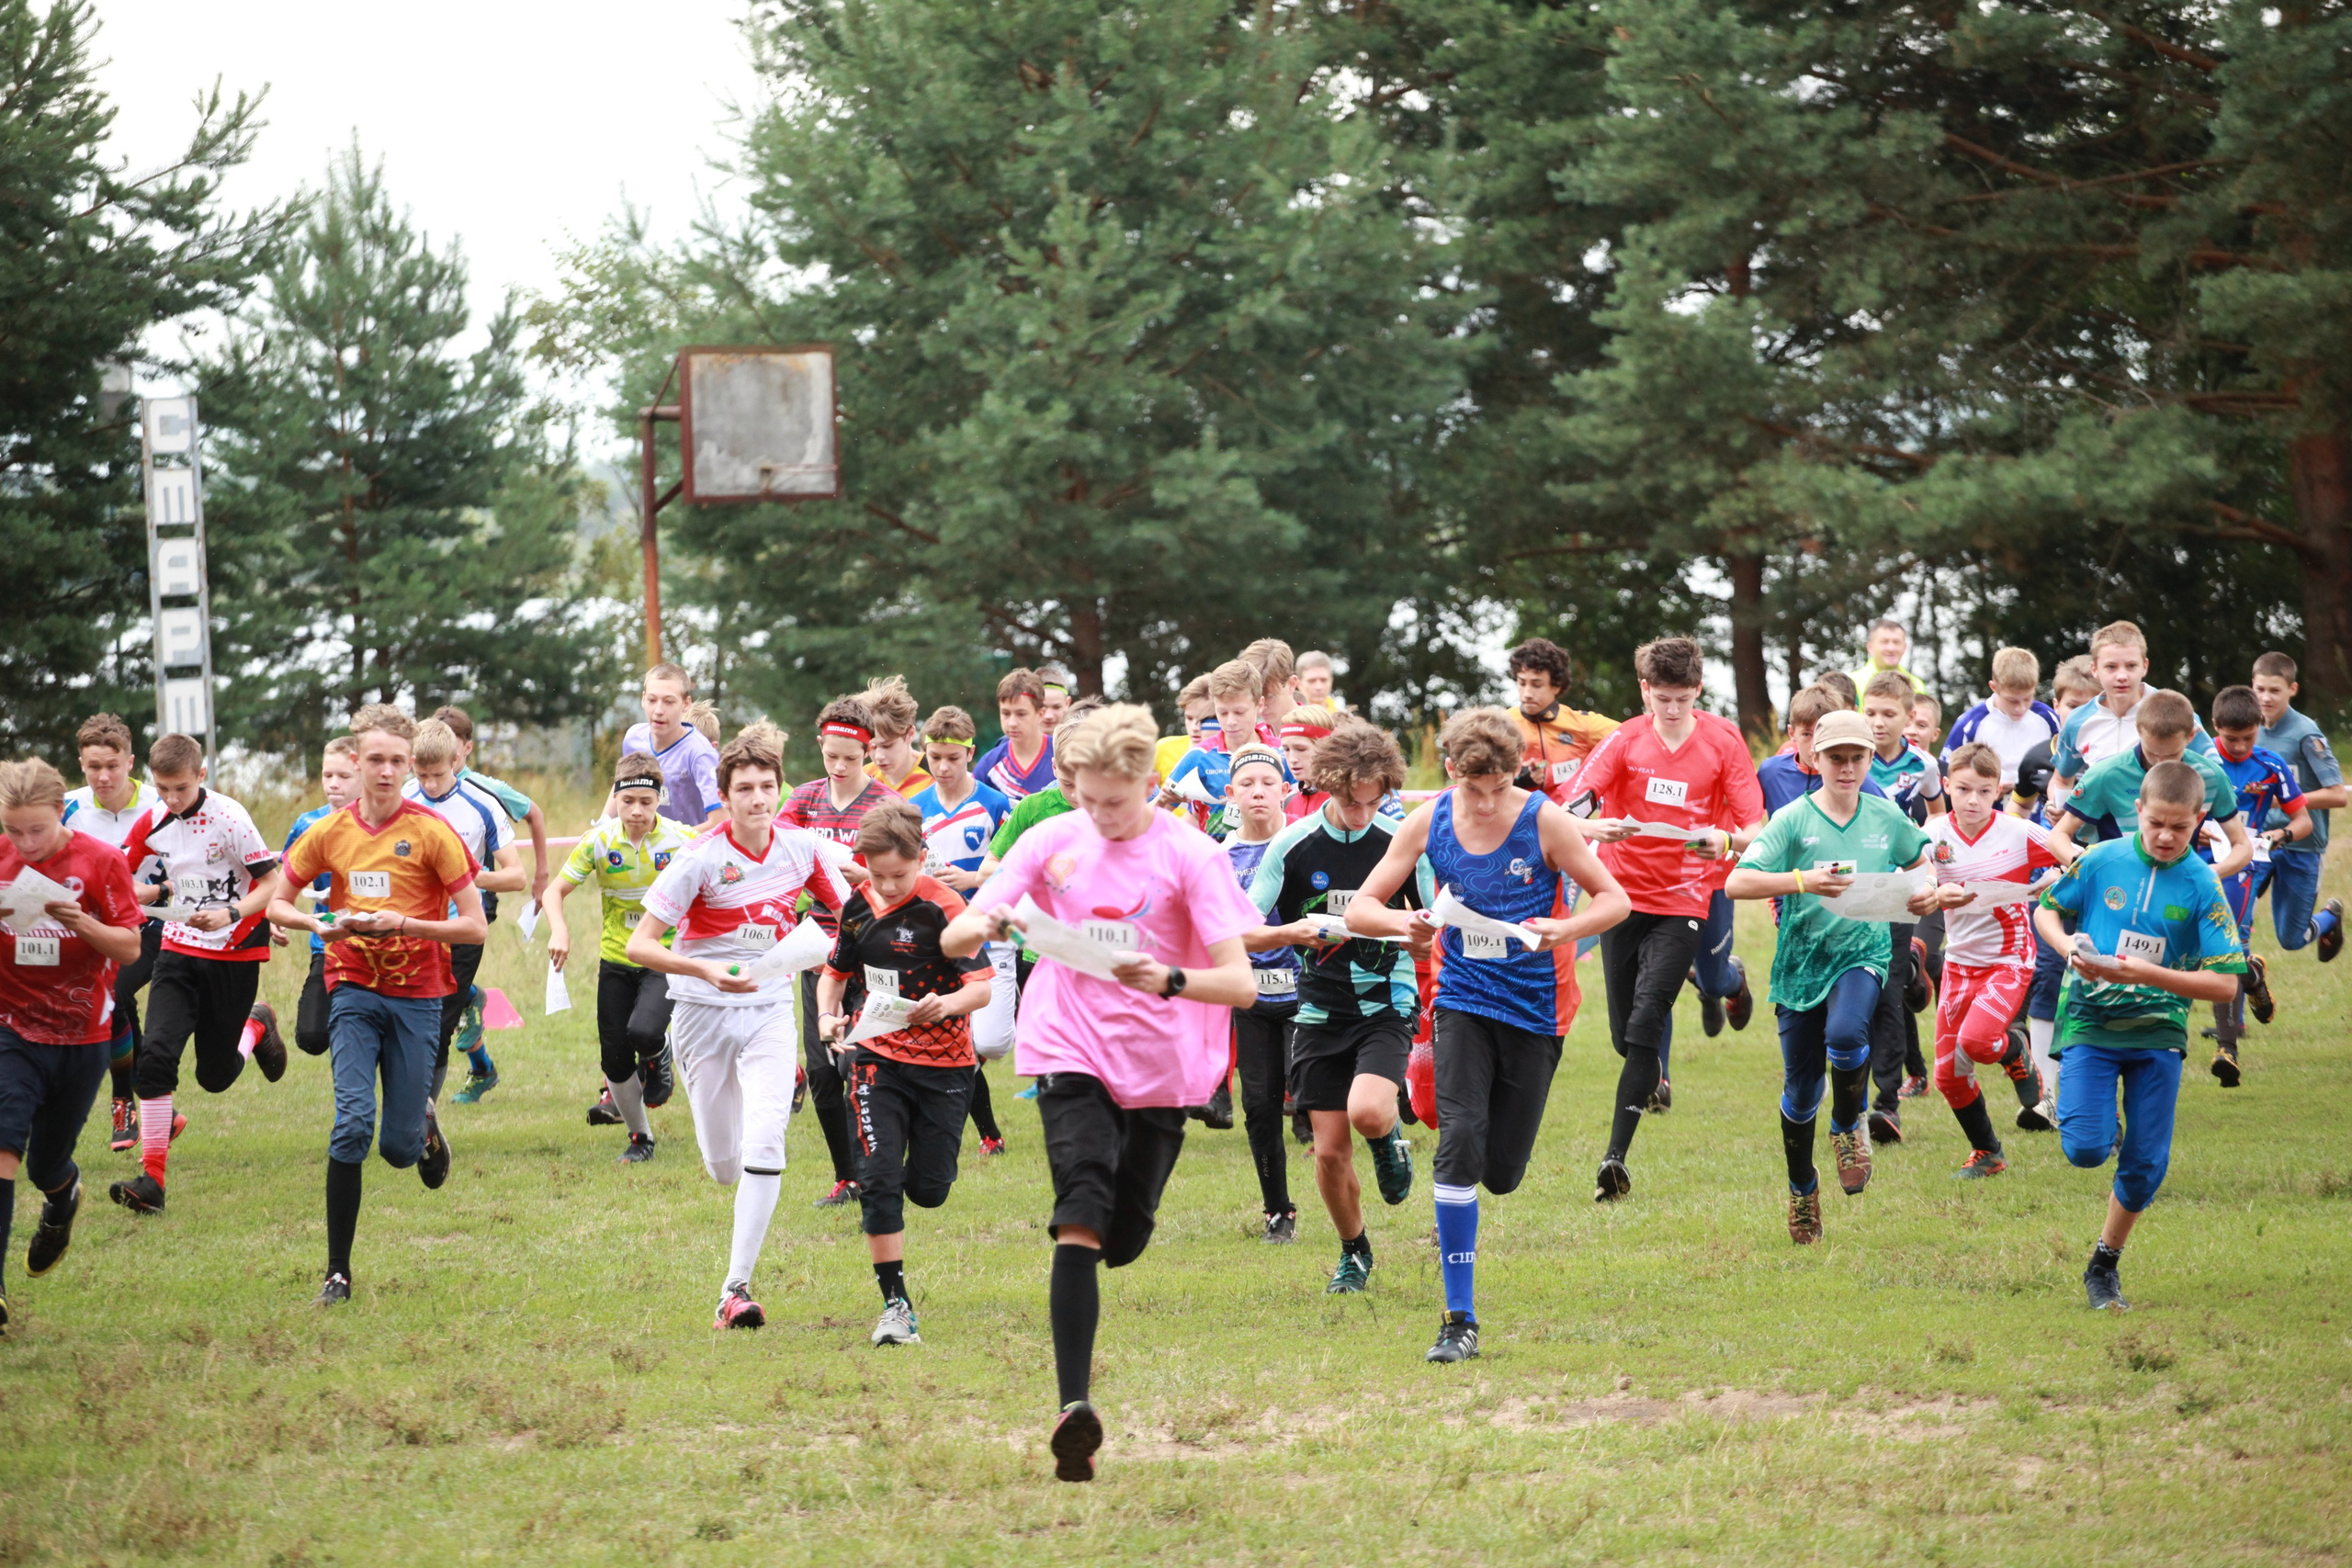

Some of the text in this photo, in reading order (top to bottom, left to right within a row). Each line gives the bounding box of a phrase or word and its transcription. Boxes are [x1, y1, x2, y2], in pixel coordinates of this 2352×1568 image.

[1235, 754, 1275, 769] noname
[1652, 783, 1683, 797] 128.1
[181, 878, 204, 889] 103.1
[354, 875, 386, 887] 102.1
[741, 928, 773, 940] 106.1
[1089, 927, 1128, 943] 110.1
[1467, 933, 1500, 947] 109.1
[21, 942, 55, 955] 101.1
[2125, 936, 2161, 953] 149.1
[868, 970, 895, 987] 108.1
[1261, 972, 1289, 985] 115.1
